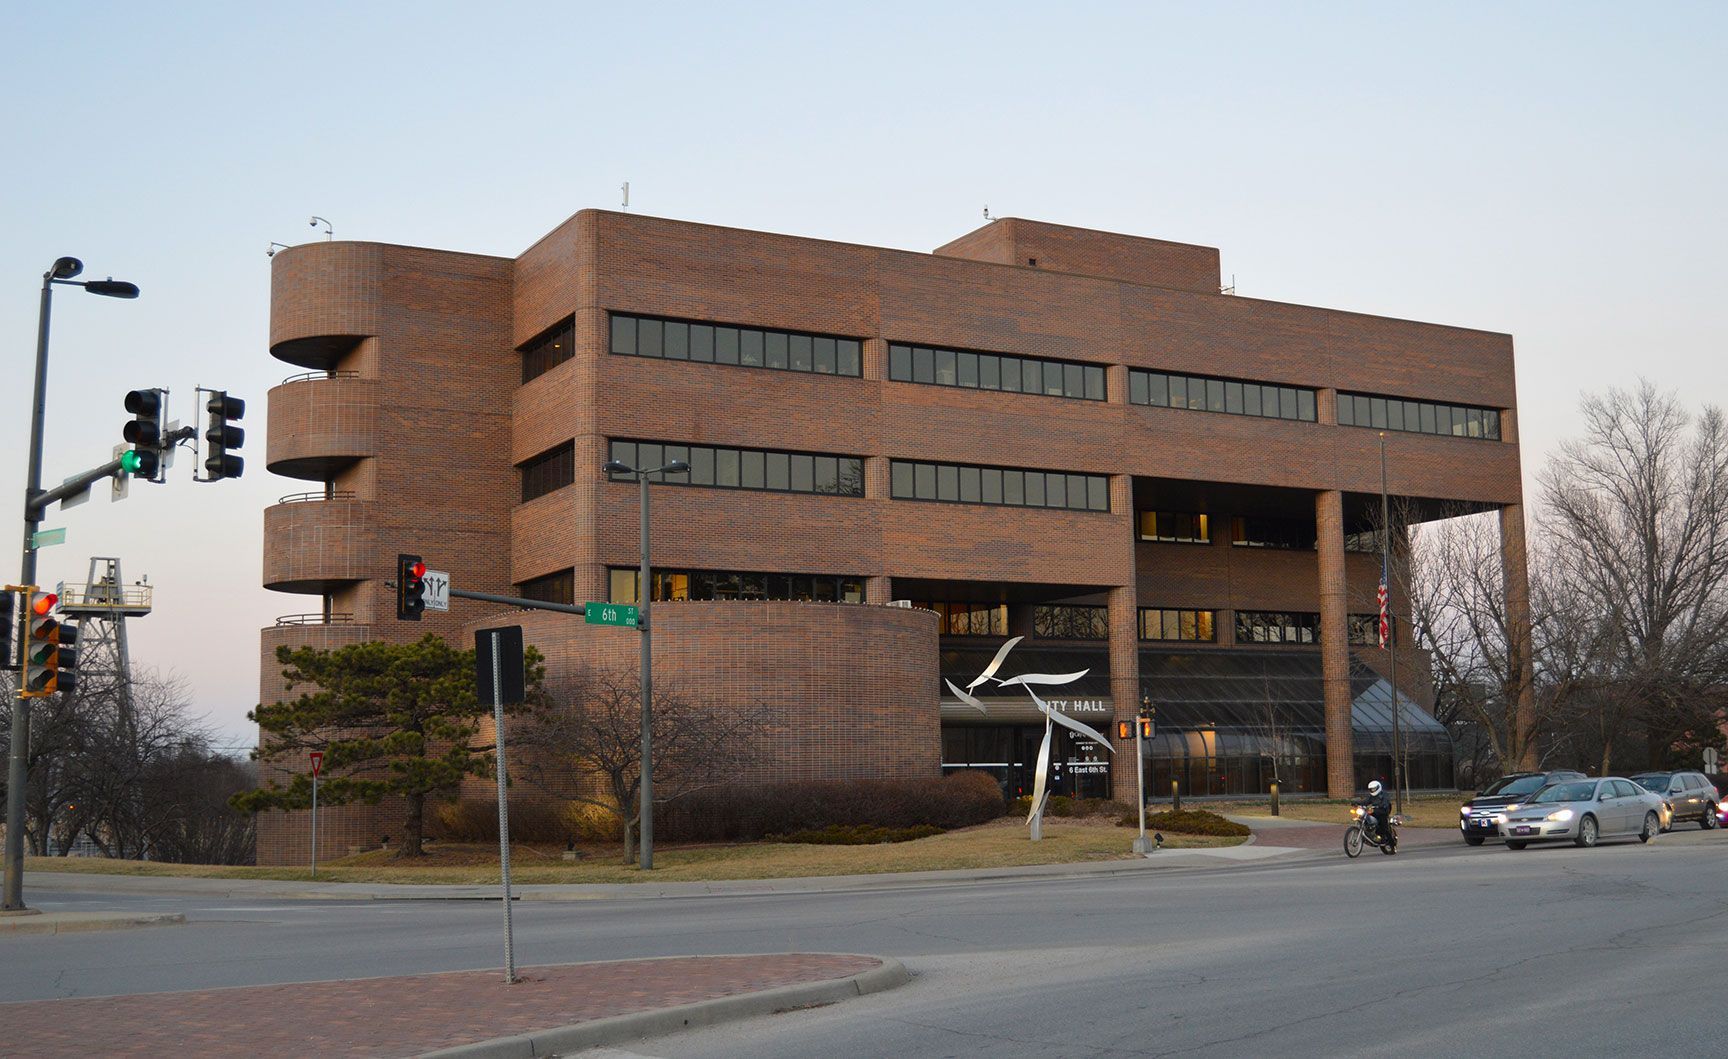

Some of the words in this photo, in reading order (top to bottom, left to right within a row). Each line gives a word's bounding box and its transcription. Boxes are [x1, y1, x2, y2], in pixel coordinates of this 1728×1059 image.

[602, 608, 616, 621] 6th
[1038, 700, 1067, 712] ITY
[1074, 700, 1106, 712] HALL
[1074, 766, 1088, 774] East
[1088, 766, 1098, 774] 6th
